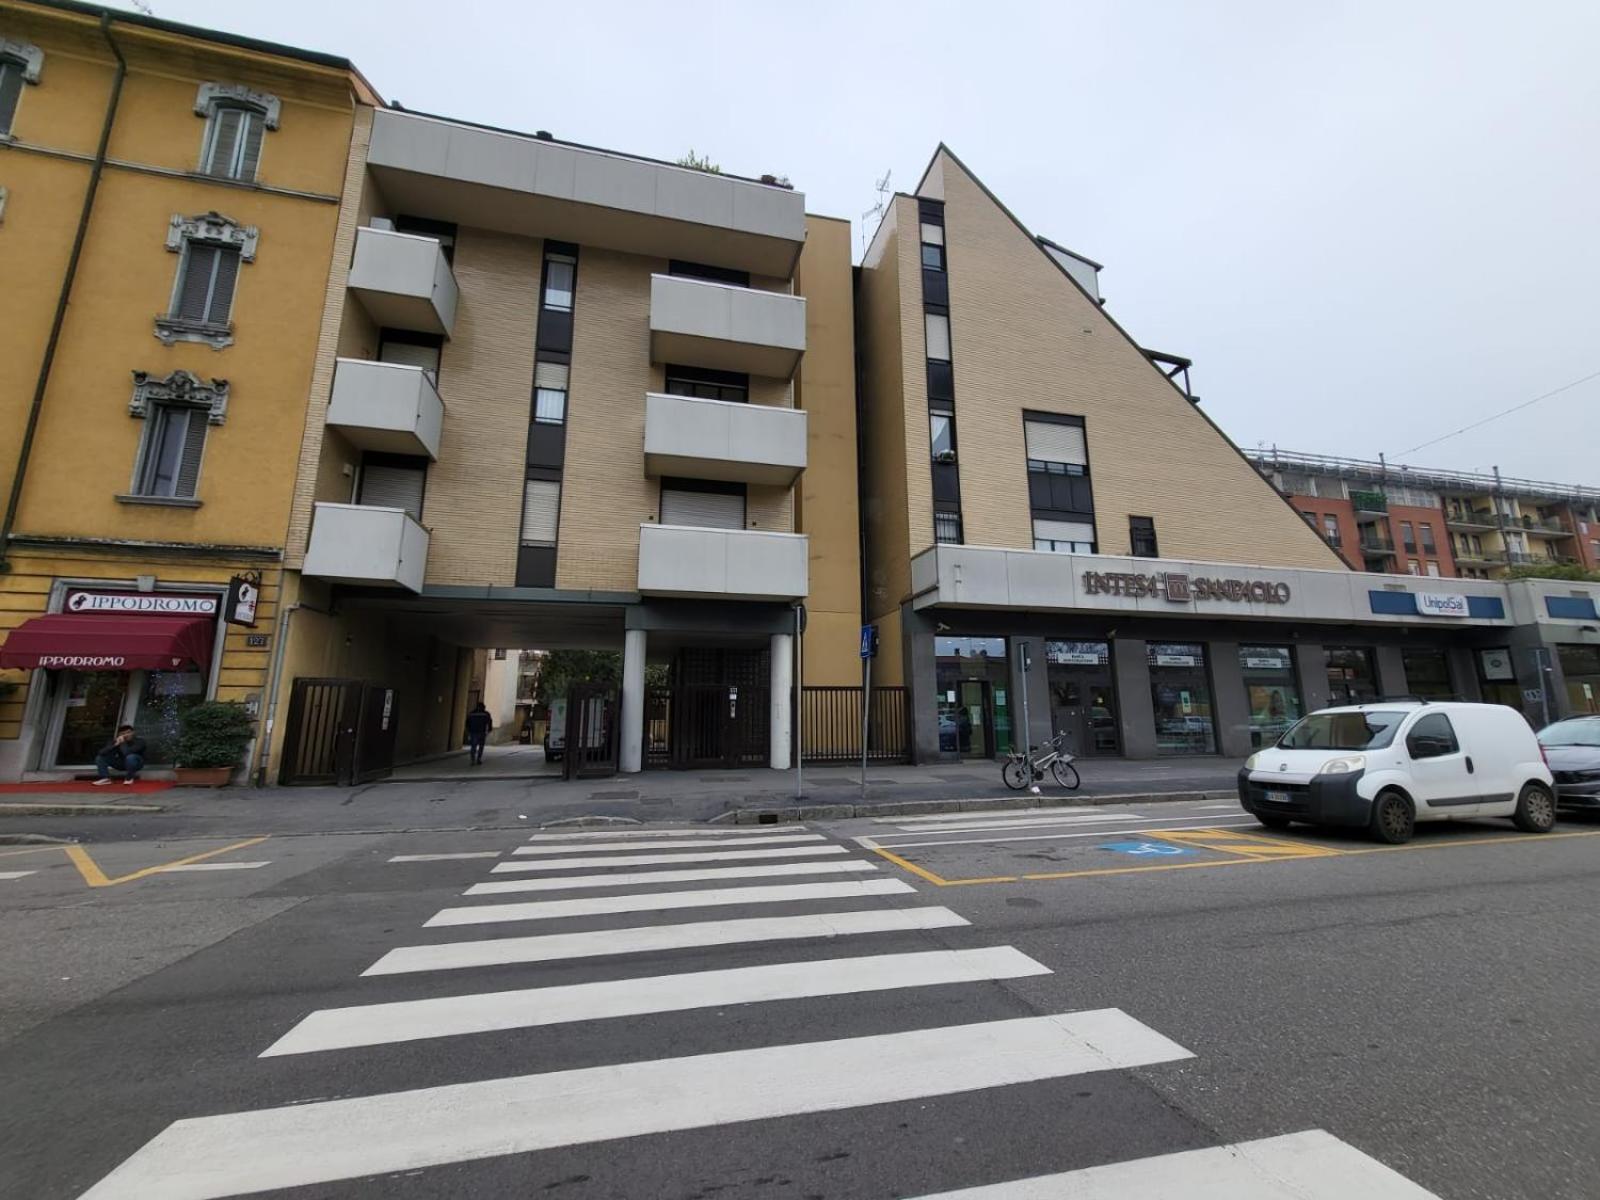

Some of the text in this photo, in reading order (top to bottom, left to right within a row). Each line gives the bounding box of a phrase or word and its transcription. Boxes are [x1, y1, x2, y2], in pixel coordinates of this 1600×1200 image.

[91, 596, 214, 612] IPPODROMO
[1423, 594, 1464, 610] UnipolSai
[38, 656, 125, 666] IPPODROMO
